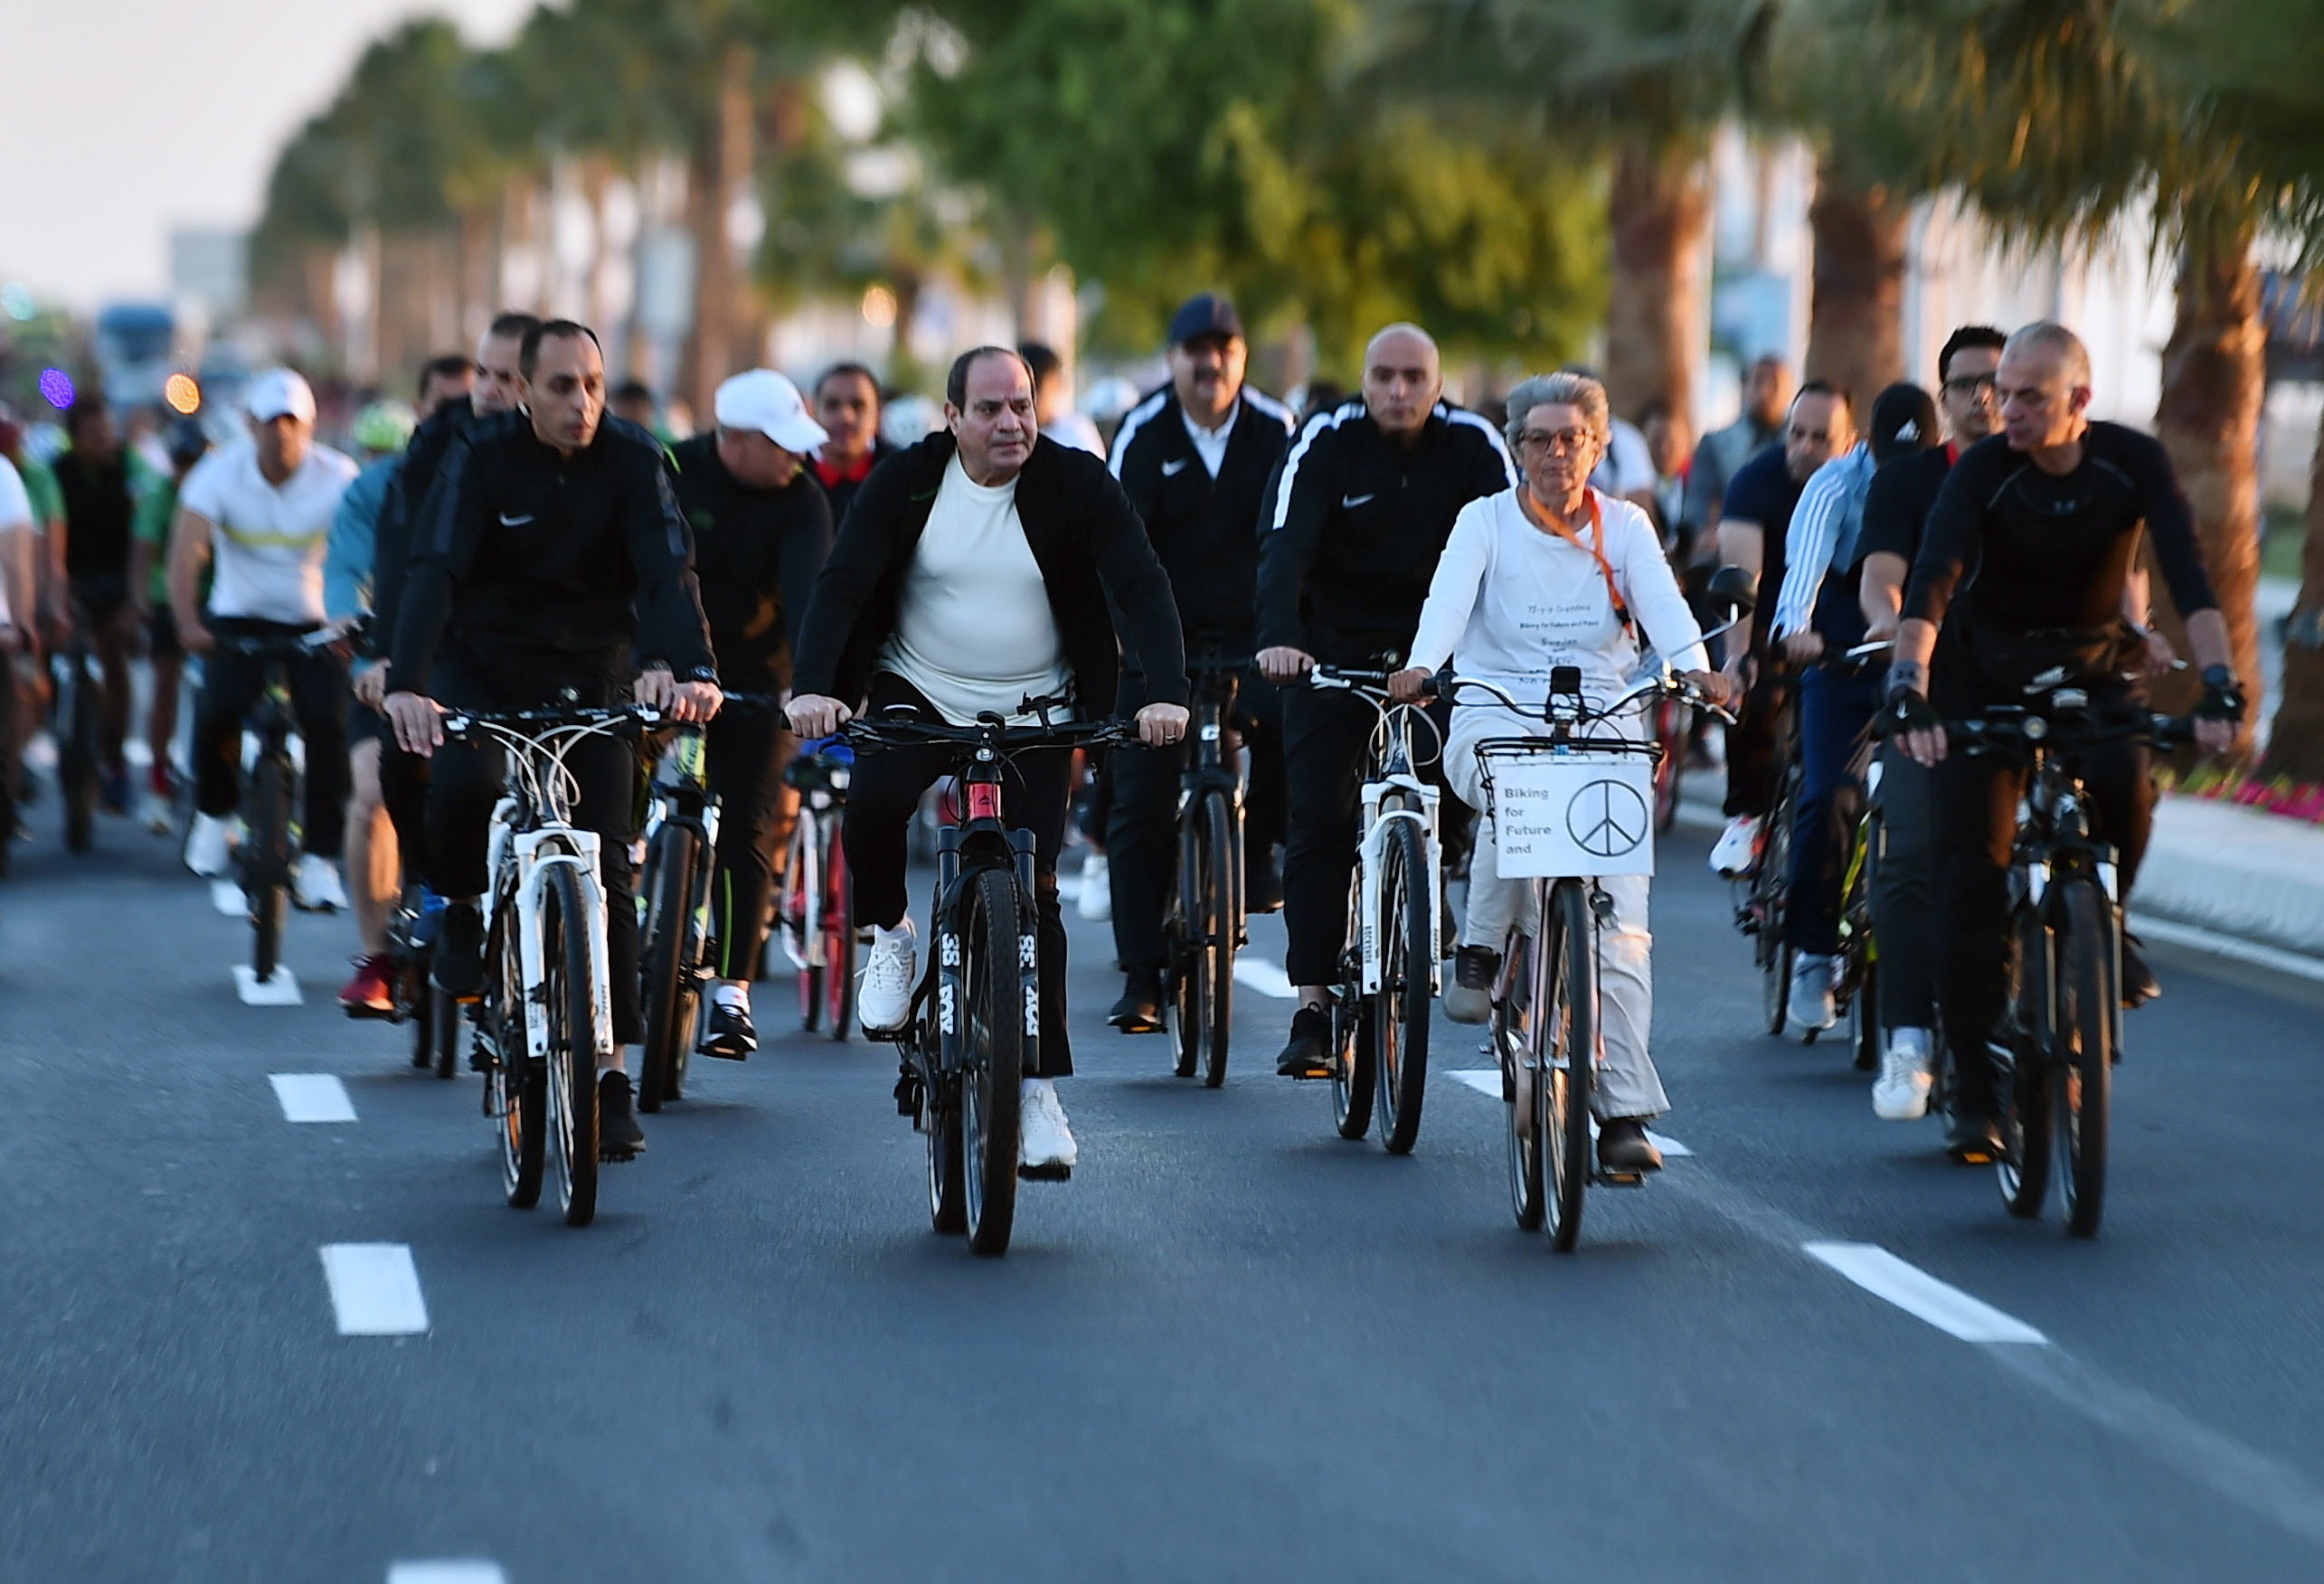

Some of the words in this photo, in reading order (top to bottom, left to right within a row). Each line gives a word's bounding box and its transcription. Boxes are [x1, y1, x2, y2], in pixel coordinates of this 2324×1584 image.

[1505, 787, 1549, 800] Biking
[1505, 806, 1526, 817] for
[1506, 825, 1553, 835] Future
[1506, 843, 1532, 854] and
[940, 984, 954, 1035] FOX
[1025, 985, 1040, 1037] FOX
